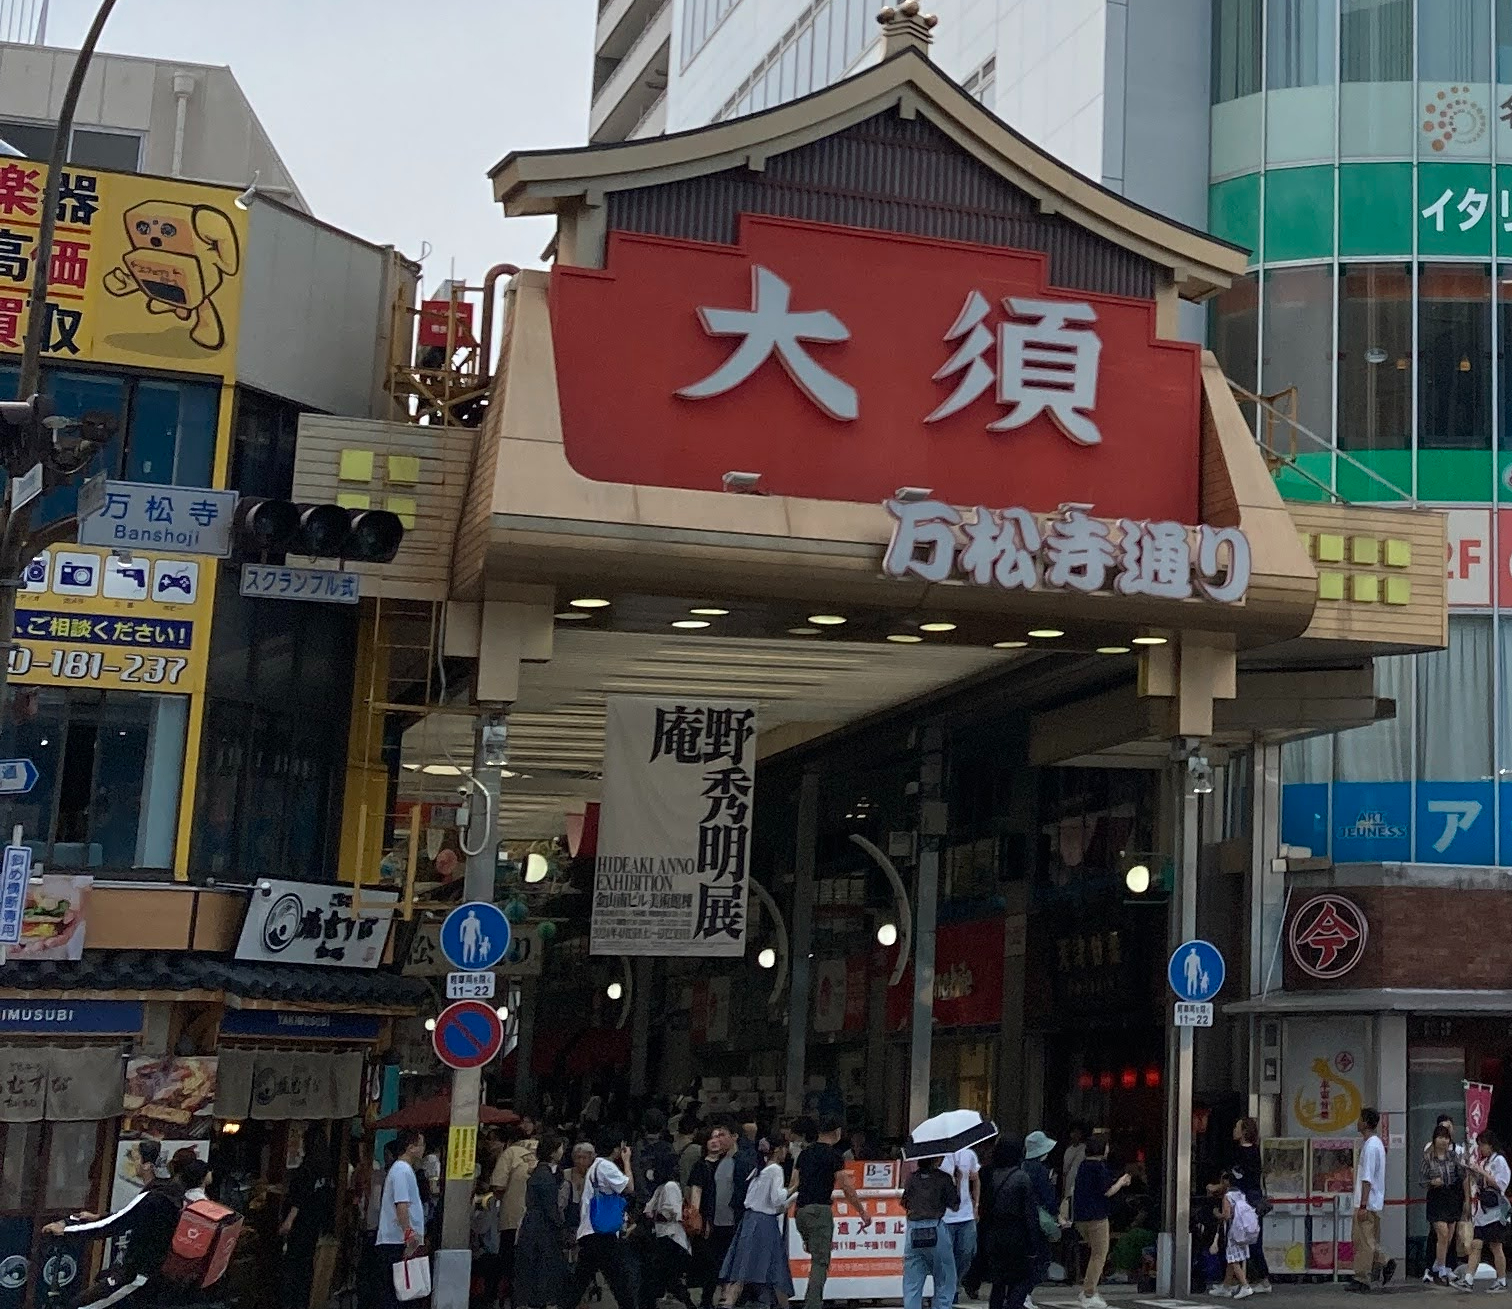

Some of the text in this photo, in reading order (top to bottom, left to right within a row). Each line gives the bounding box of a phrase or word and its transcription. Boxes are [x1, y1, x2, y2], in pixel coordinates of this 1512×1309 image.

[676, 264, 1103, 446] 大須
[100, 492, 219, 527] 万松寺
[114, 524, 200, 547] Banshoji
[884, 499, 1252, 604] 万松寺通り
[598, 856, 695, 875] HIDEAKI ANNO
[596, 874, 673, 892] EXHIBITION
[452, 986, 490, 997] 11-22
[1178, 1015, 1209, 1025] 11-22
[866, 1164, 892, 1177] B-5
